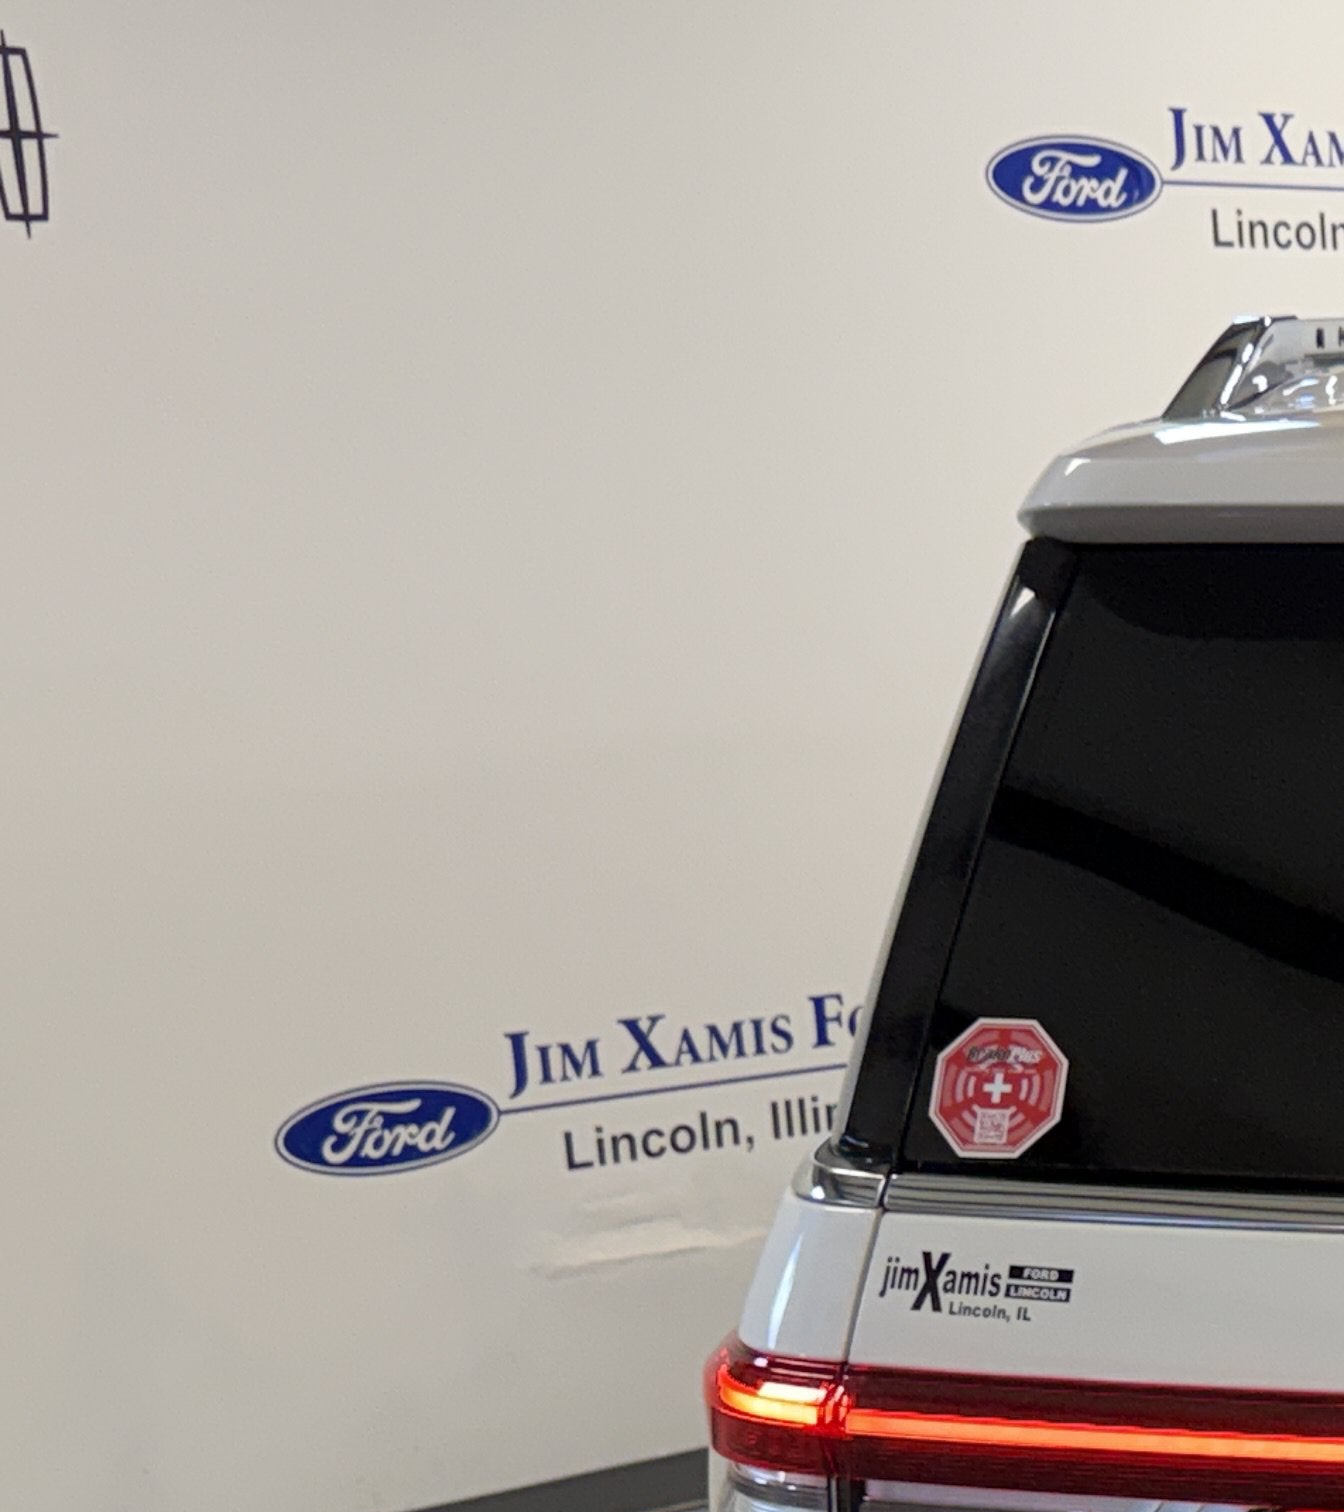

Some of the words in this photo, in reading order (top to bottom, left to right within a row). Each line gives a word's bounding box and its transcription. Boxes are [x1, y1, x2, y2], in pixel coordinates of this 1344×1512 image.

[1168, 107, 1244, 170] JIM
[1022, 150, 1128, 209] Ford
[504, 1031, 603, 1099] JIM
[617, 1014, 794, 1075] XAMIS
[322, 1099, 457, 1165] Ford
[563, 1111, 755, 1171] Lincoln,
[1009, 1285, 1067, 1301] LINCOLN
[1023, 1267, 1059, 1281] FORD
[948, 1301, 1010, 1323] Lincoln,
[1016, 1306, 1031, 1321] IL
